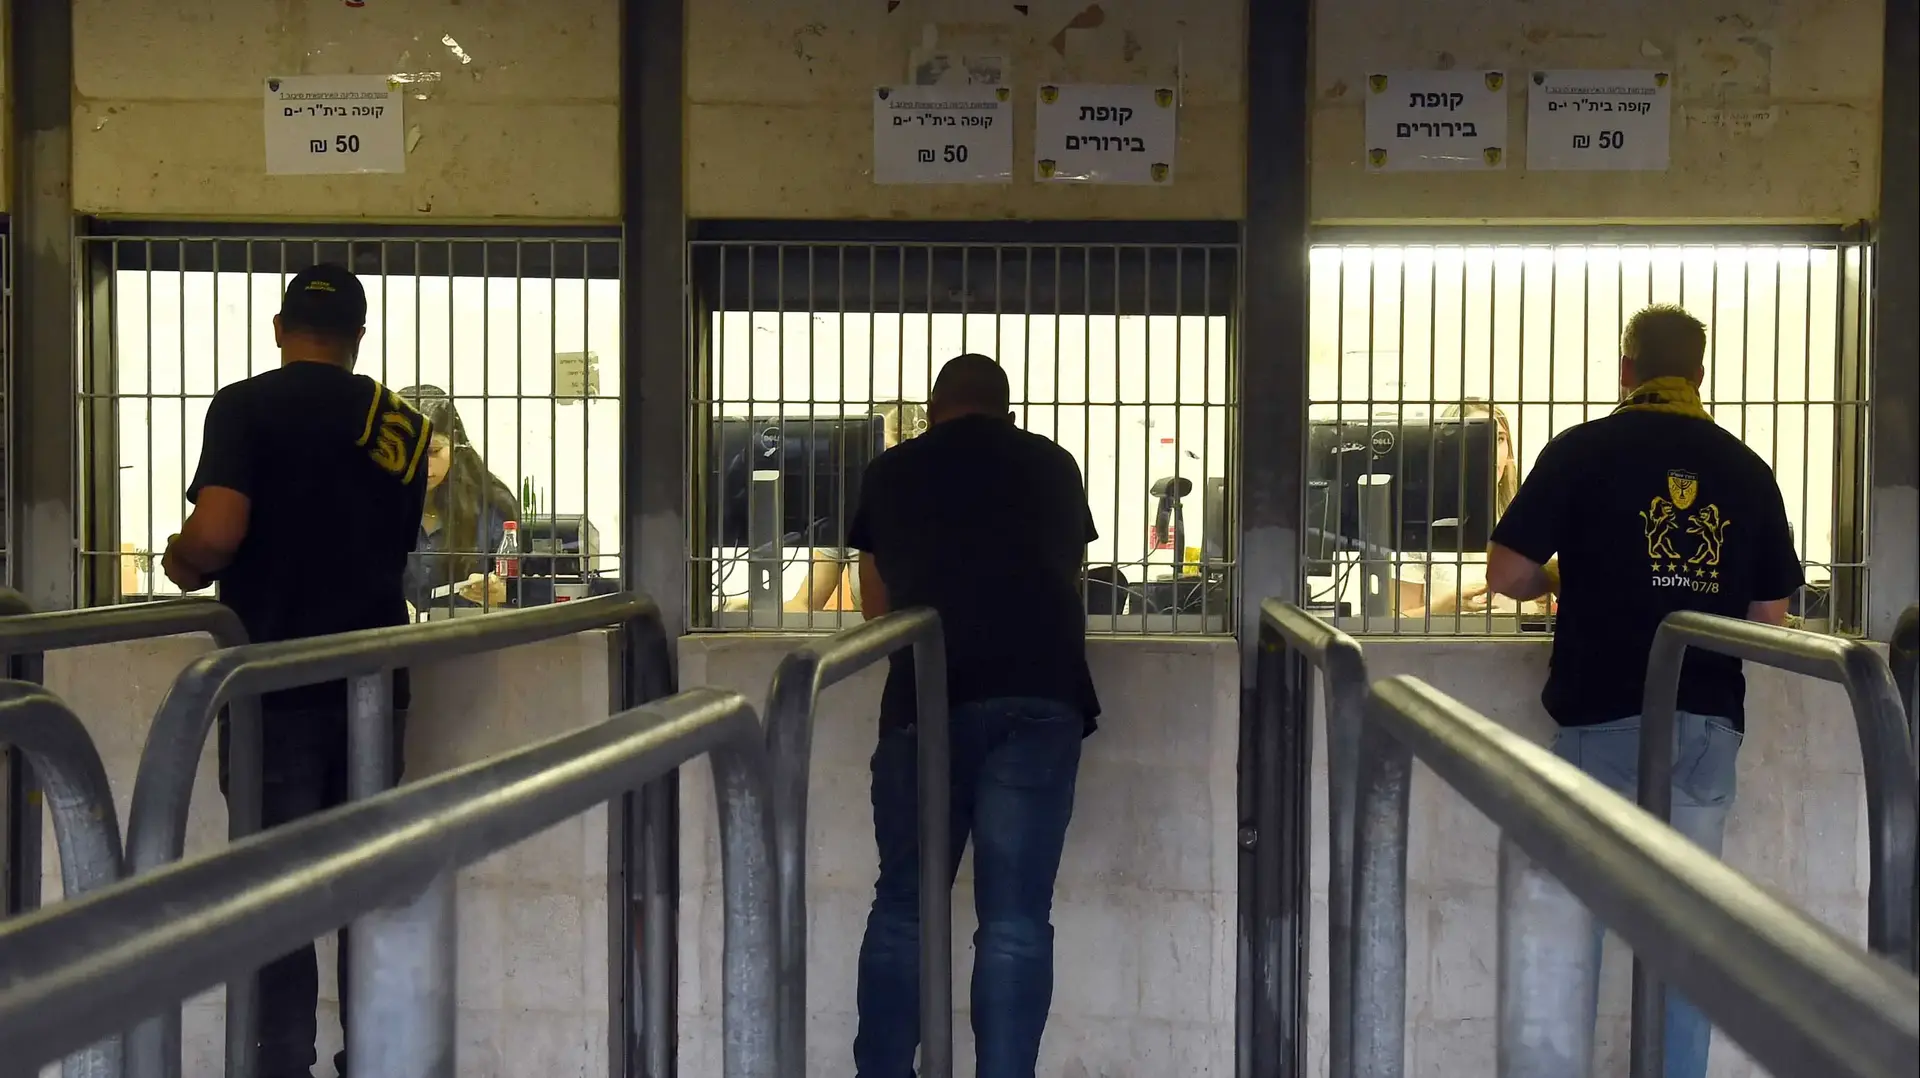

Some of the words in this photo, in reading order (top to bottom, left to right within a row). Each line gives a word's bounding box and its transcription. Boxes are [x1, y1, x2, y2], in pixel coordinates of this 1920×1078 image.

[1409, 92, 1464, 111] קופת
[1548, 102, 1567, 111] י-ם
[1572, 99, 1613, 112] בית"ר
[1618, 101, 1651, 115] קופה
[284, 107, 302, 116] י-ם
[308, 104, 347, 116] בית"ר
[352, 106, 384, 118] קופה
[1079, 106, 1133, 126] קופת
[893, 116, 911, 126] י-ם
[916, 113, 956, 126] בית"ר
[961, 115, 993, 129] קופה
[1396, 122, 1477, 138] בירורים
[310, 140, 327, 153] ₪
[336, 135, 360, 153] 50
[1066, 135, 1145, 152] בירורים
[1572, 135, 1590, 149] ₪
[1598, 131, 1624, 149] 50
[918, 149, 935, 163] ₪
[943, 145, 968, 163] 50
[1652, 573, 1691, 587] אלופה
[1691, 580, 1720, 594] 07/8
